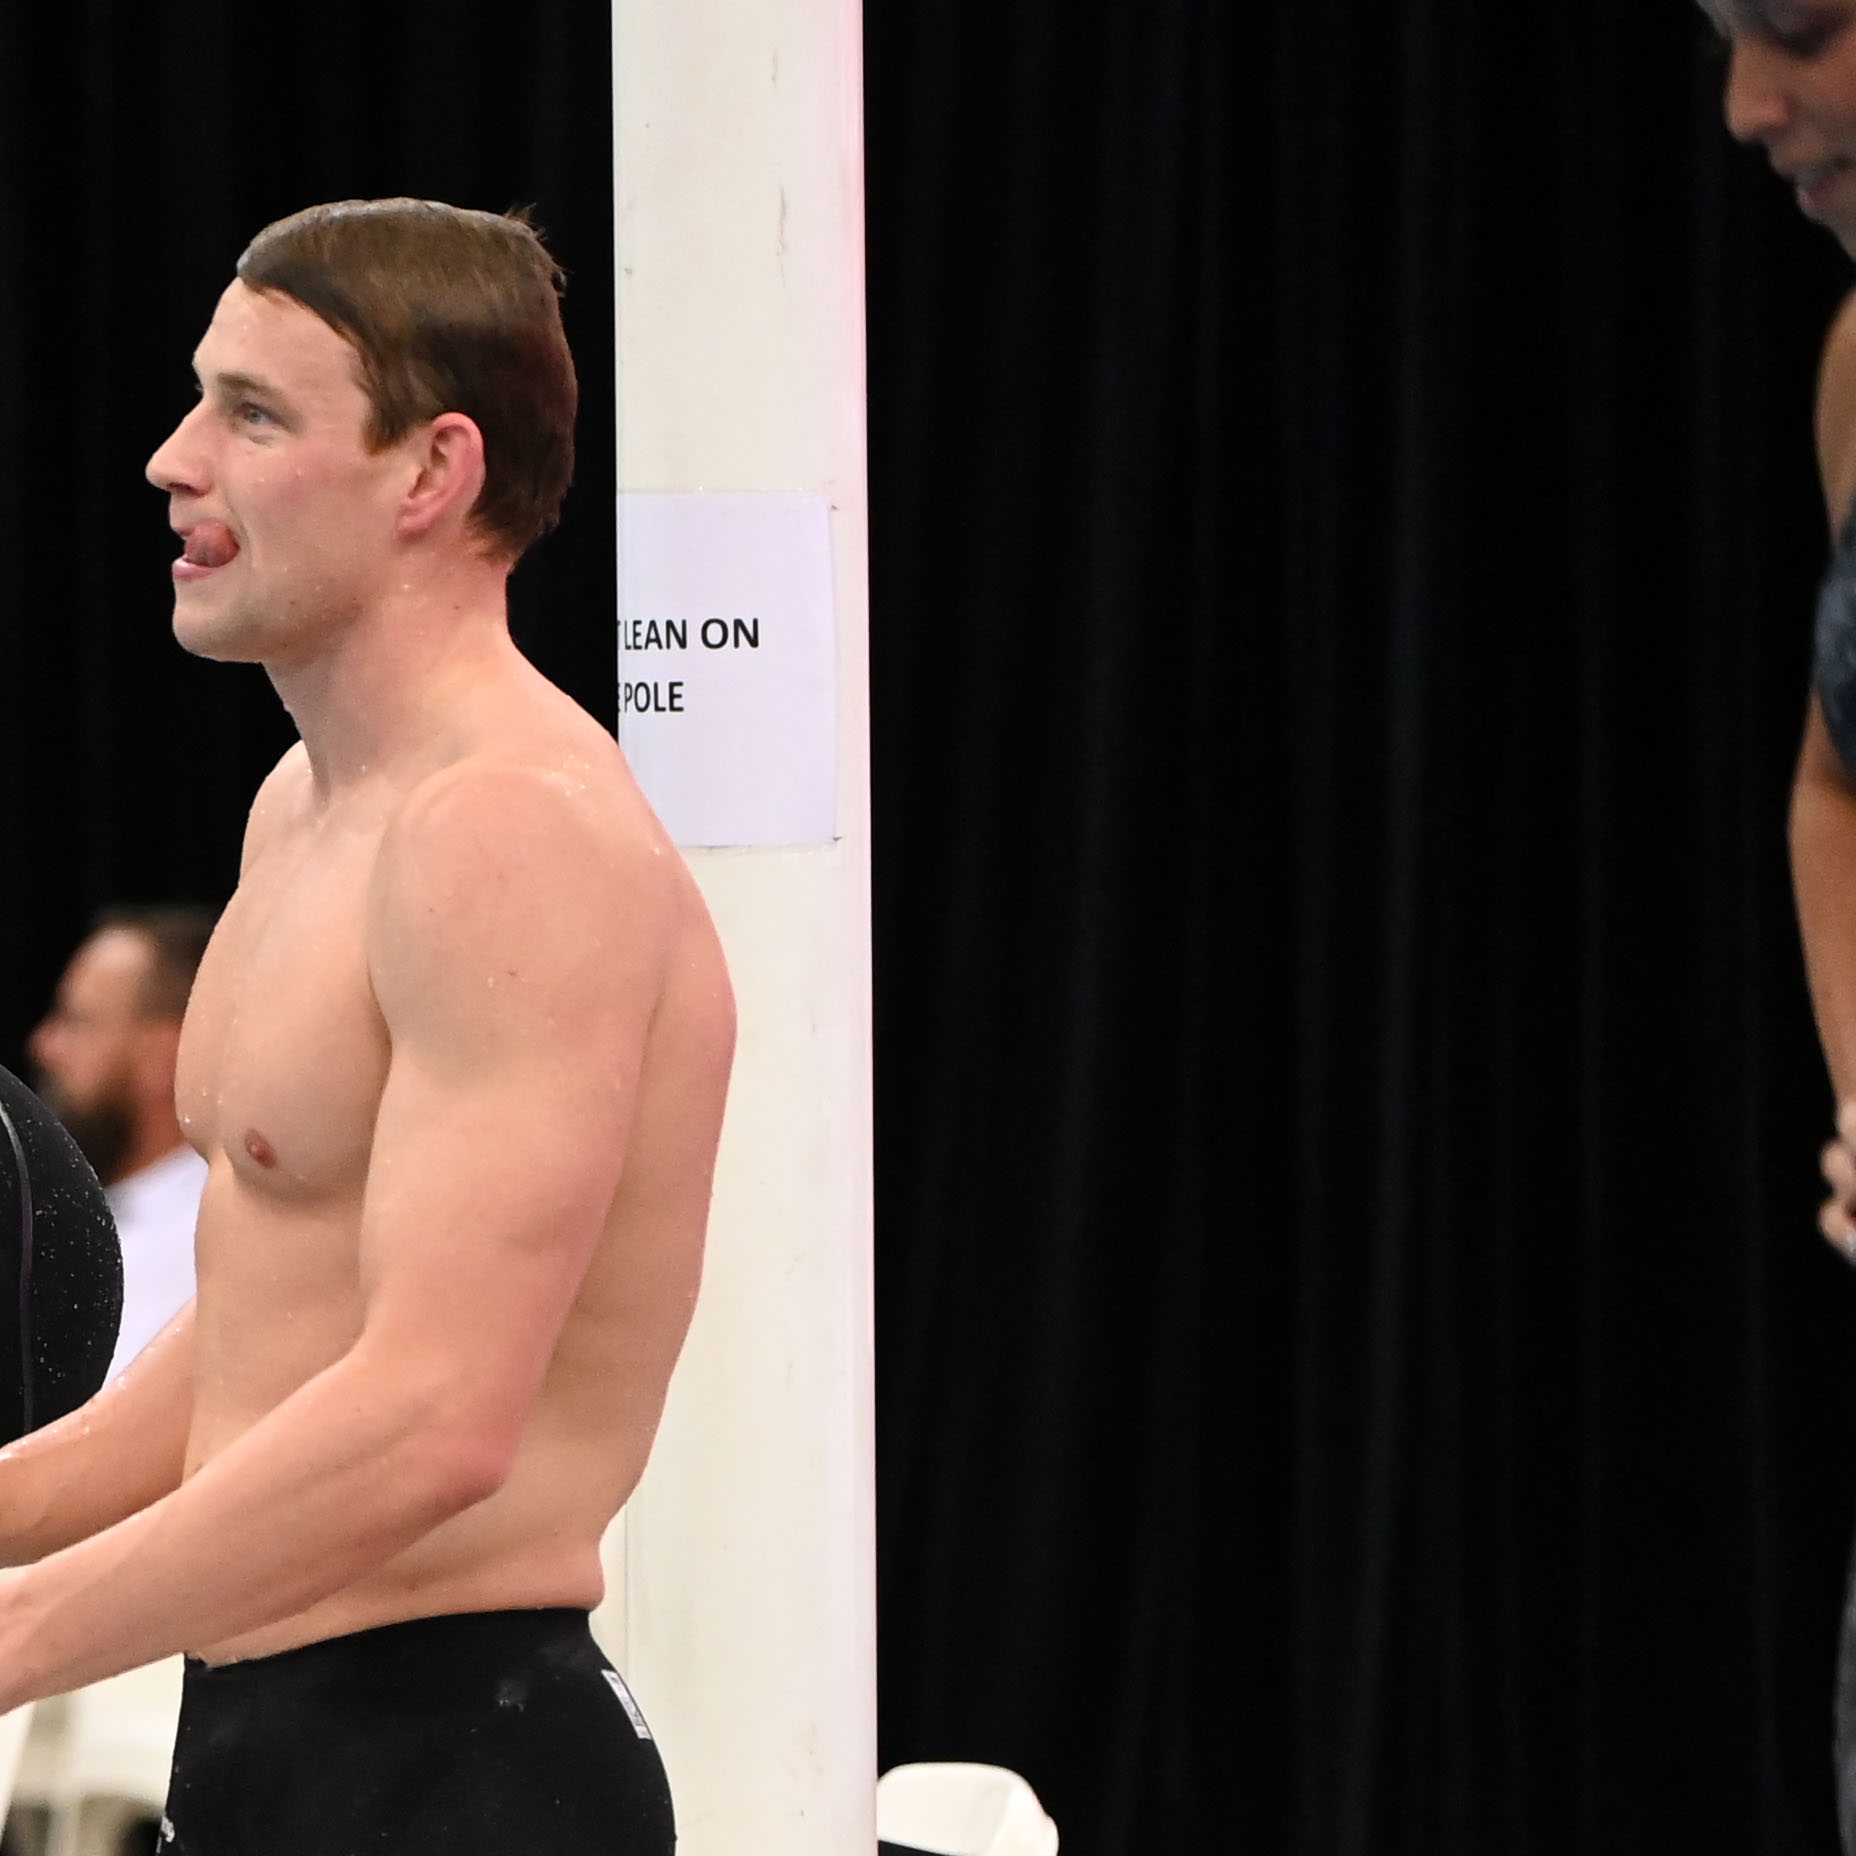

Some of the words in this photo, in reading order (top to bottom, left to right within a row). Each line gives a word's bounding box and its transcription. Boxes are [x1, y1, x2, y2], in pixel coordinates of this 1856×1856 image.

[624, 619, 687, 650] LEAN
[700, 617, 759, 650] ON
[624, 680, 685, 713] POLE
